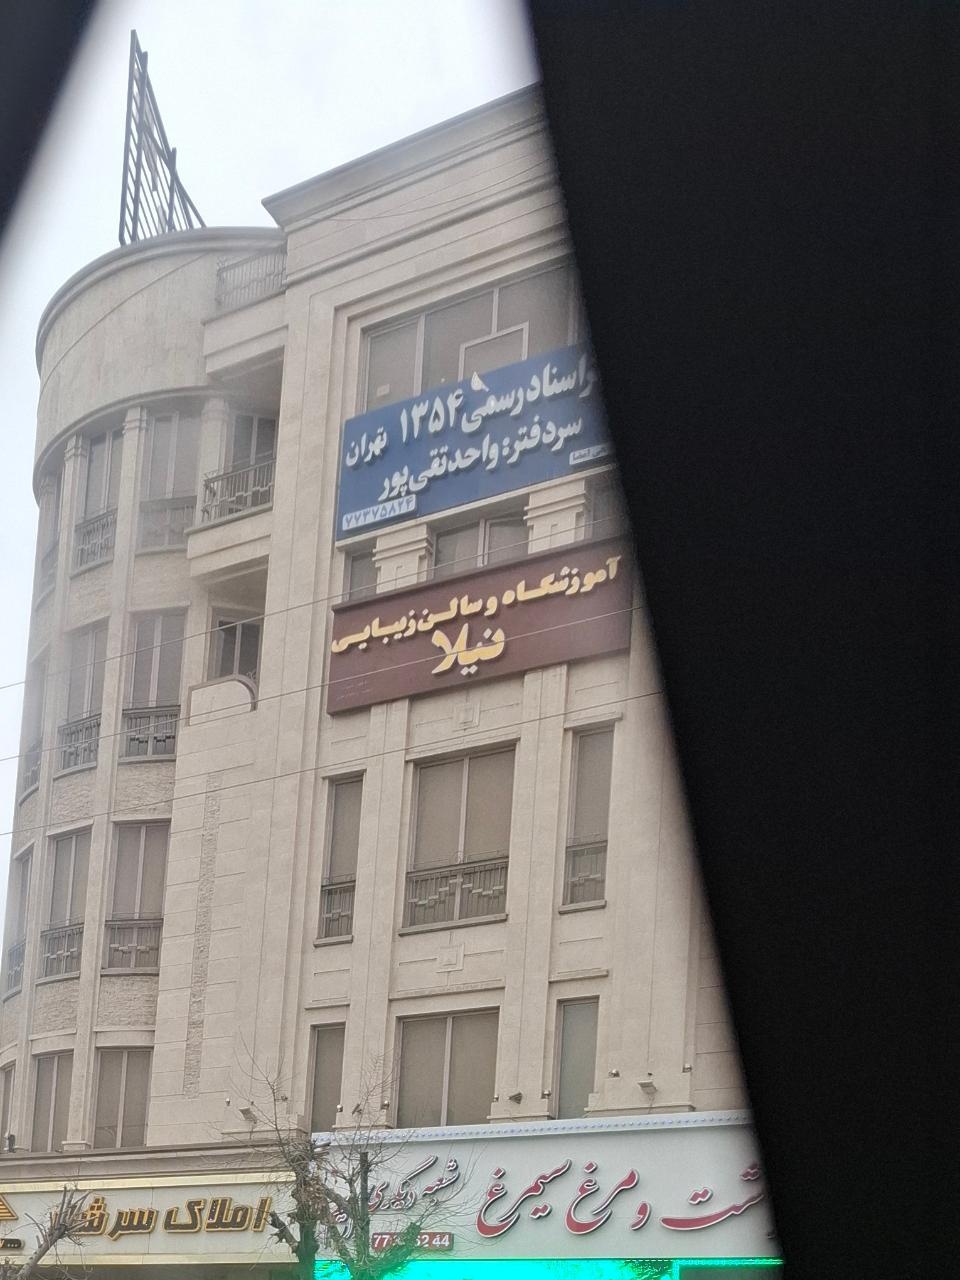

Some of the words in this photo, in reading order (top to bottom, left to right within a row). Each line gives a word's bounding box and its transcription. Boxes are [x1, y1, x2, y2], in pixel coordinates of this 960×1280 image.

[527, 353, 587, 402] اسناد
[400, 388, 465, 443] ۱۳۵۴
[461, 386, 524, 434] رسمی
[345, 426, 388, 468] تهران
[448, 434, 500, 472] واحد
[502, 555, 622, 606] آموزشگاه
[417, 594, 483, 632] سالن
[484, 595, 499, 617] و
[331, 609, 418, 654] زیبایی
[162, 1196, 273, 1233] املاک
[475, 1158, 572, 1238] سیمرغ
[564, 1161, 640, 1236] مرغ
[630, 1200, 652, 1231] و
